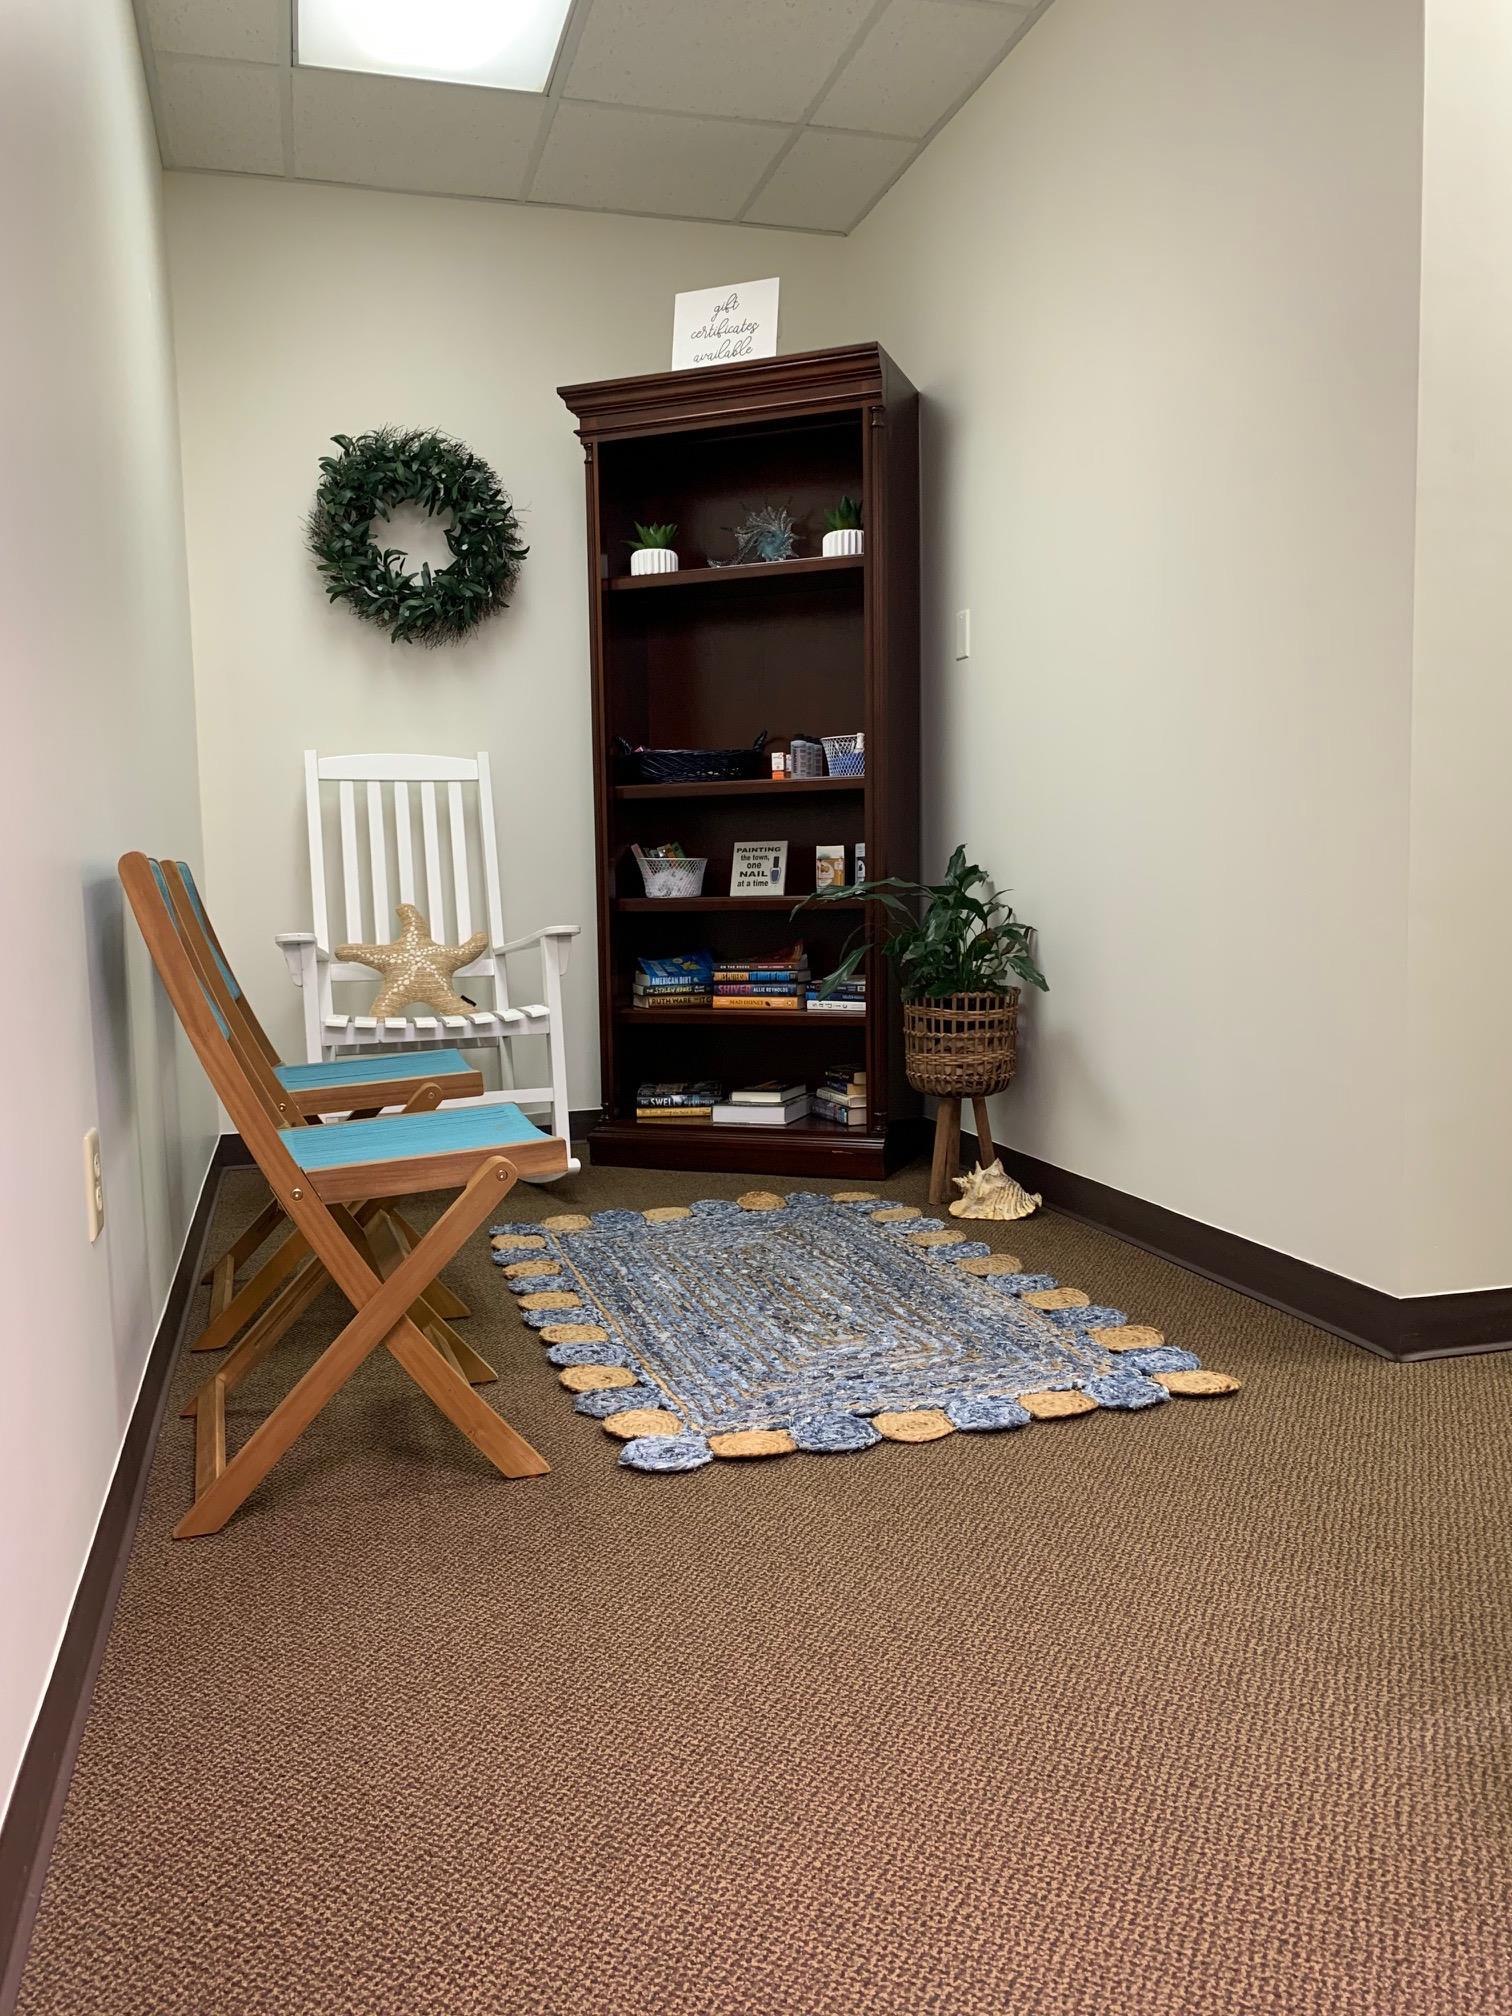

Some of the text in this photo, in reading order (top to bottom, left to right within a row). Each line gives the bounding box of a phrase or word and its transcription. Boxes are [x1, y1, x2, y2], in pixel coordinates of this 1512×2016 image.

[711, 293, 740, 322] gift
[690, 318, 760, 340] certificates
[693, 336, 753, 363] available
[736, 846, 782, 854] PAINTING
[752, 854, 770, 862] town,
[739, 870, 768, 878] NAIL
[752, 879, 769, 887] time
[651, 976, 692, 986] AMERICAN DIRT
[718, 984, 753, 994] SHIVER
[650, 1097, 675, 1107] SWEL
